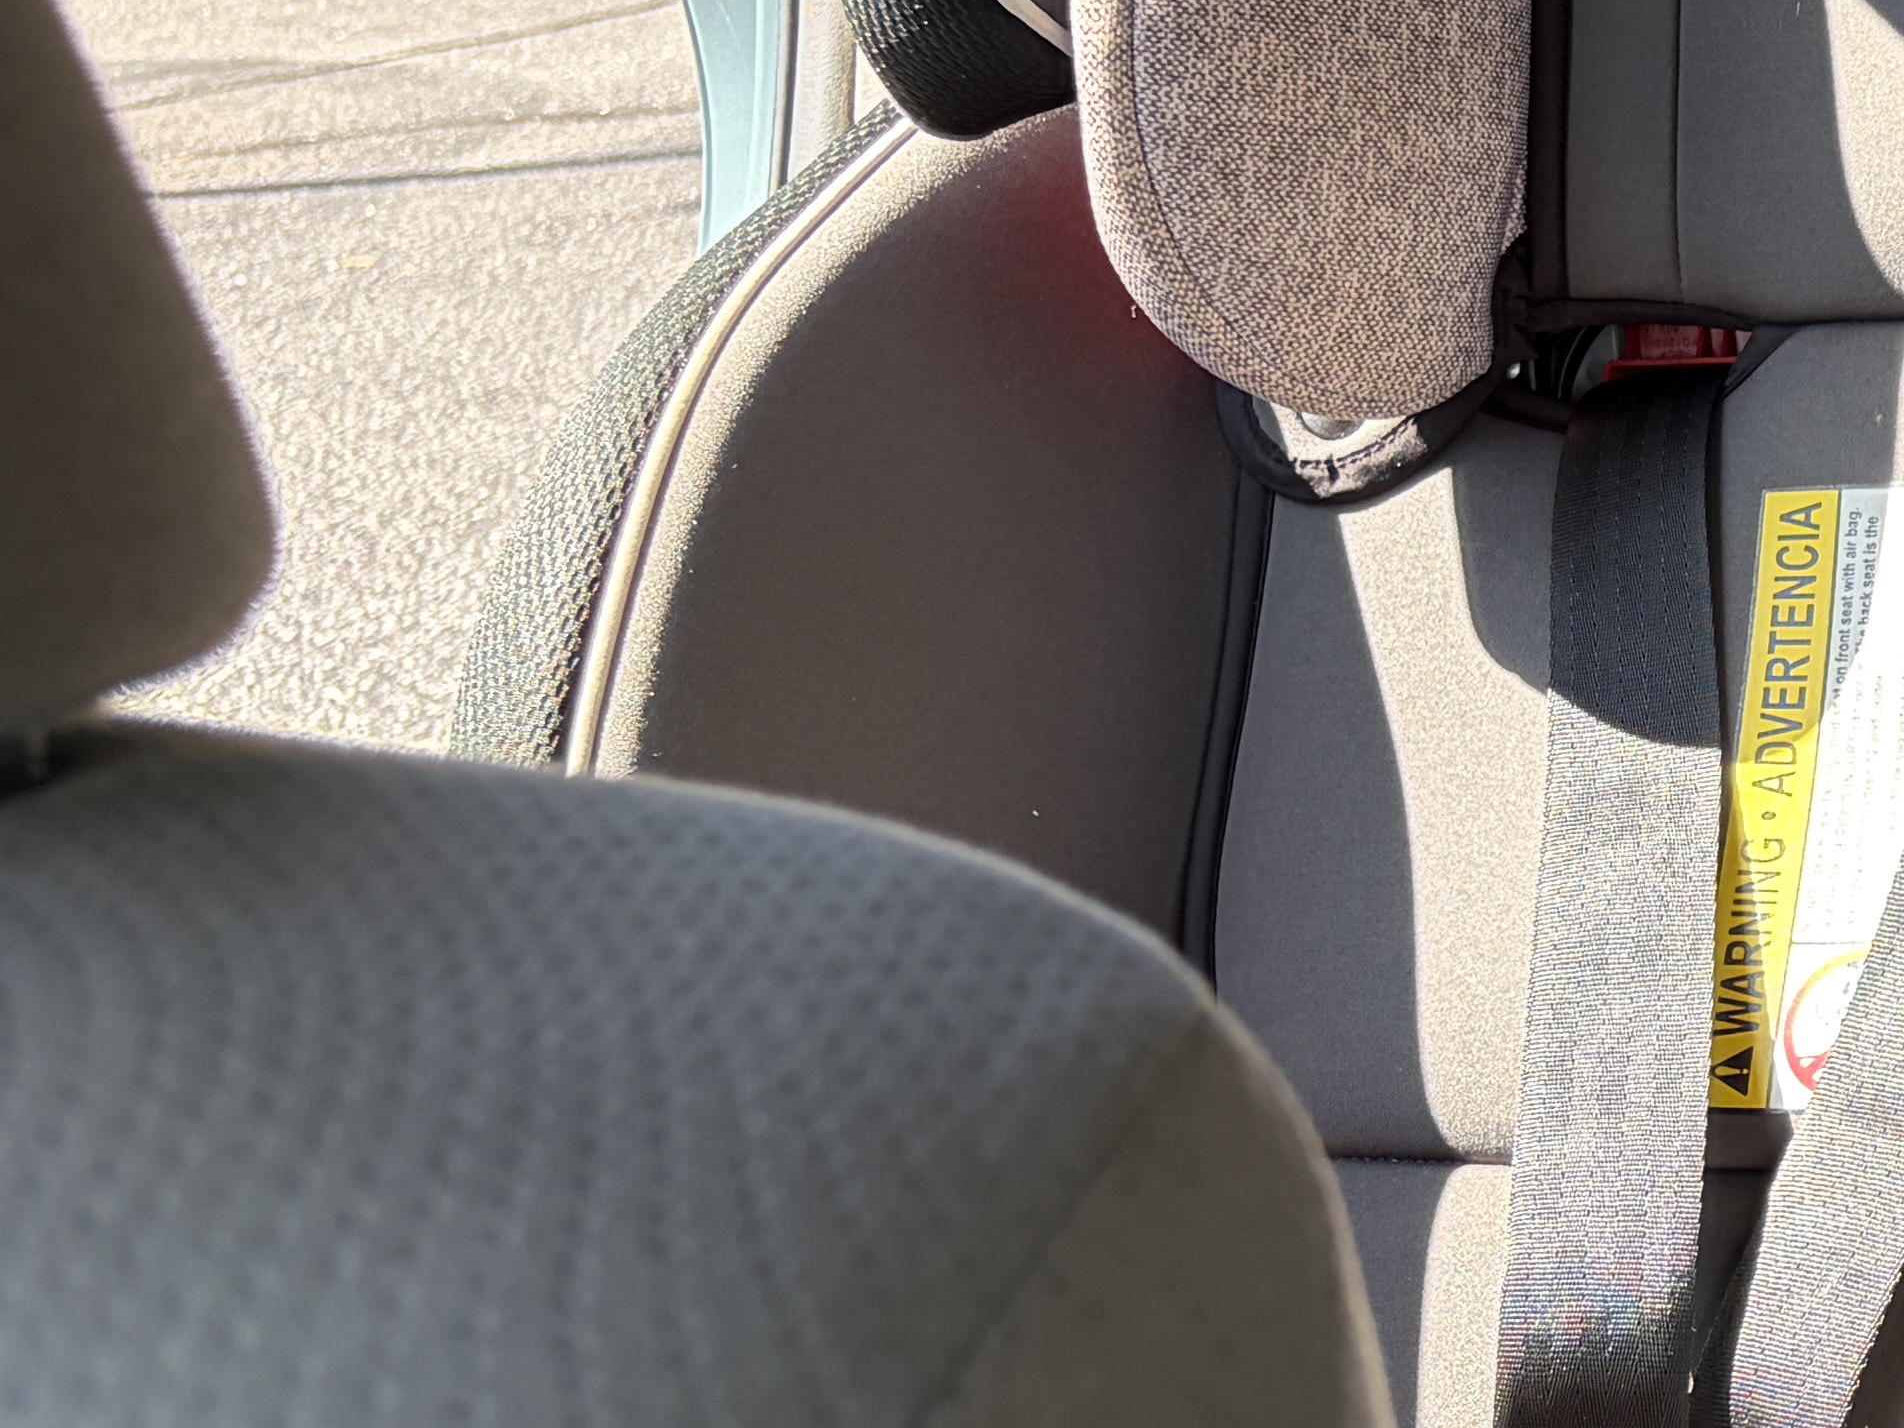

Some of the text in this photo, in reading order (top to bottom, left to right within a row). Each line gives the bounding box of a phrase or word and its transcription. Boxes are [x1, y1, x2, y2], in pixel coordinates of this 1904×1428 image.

[1844, 508, 1862, 537] bag.
[1864, 516, 1879, 538] the
[1844, 541, 1857, 558] air
[1863, 542, 1877, 554] is
[1842, 563, 1856, 592] with
[1861, 558, 1877, 588] seat
[1839, 595, 1854, 625] seat
[1834, 629, 1851, 662] front
[1713, 837, 1786, 1037] WARNING
[1751, 501, 1822, 798] ADVERTENCIA
